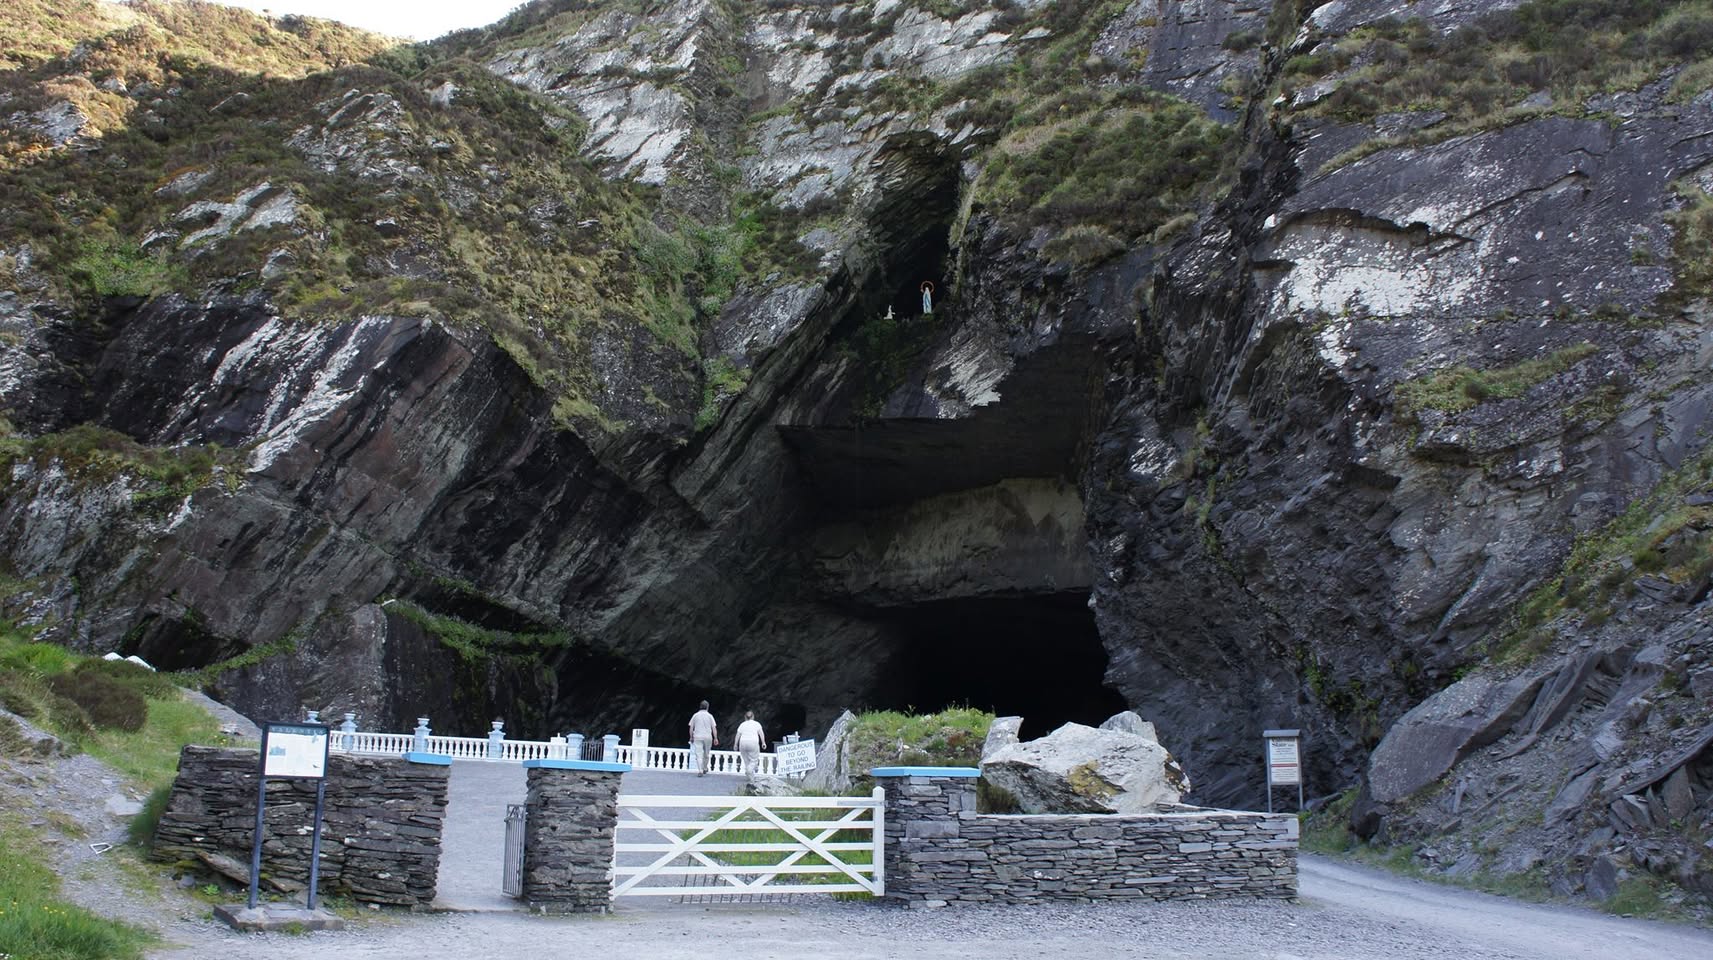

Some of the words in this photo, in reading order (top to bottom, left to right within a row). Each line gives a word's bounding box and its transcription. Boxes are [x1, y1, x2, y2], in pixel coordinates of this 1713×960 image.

[779, 741, 814, 753] DANGEROUS
[785, 757, 808, 765] BEYOND
[793, 762, 815, 770] RAILING
